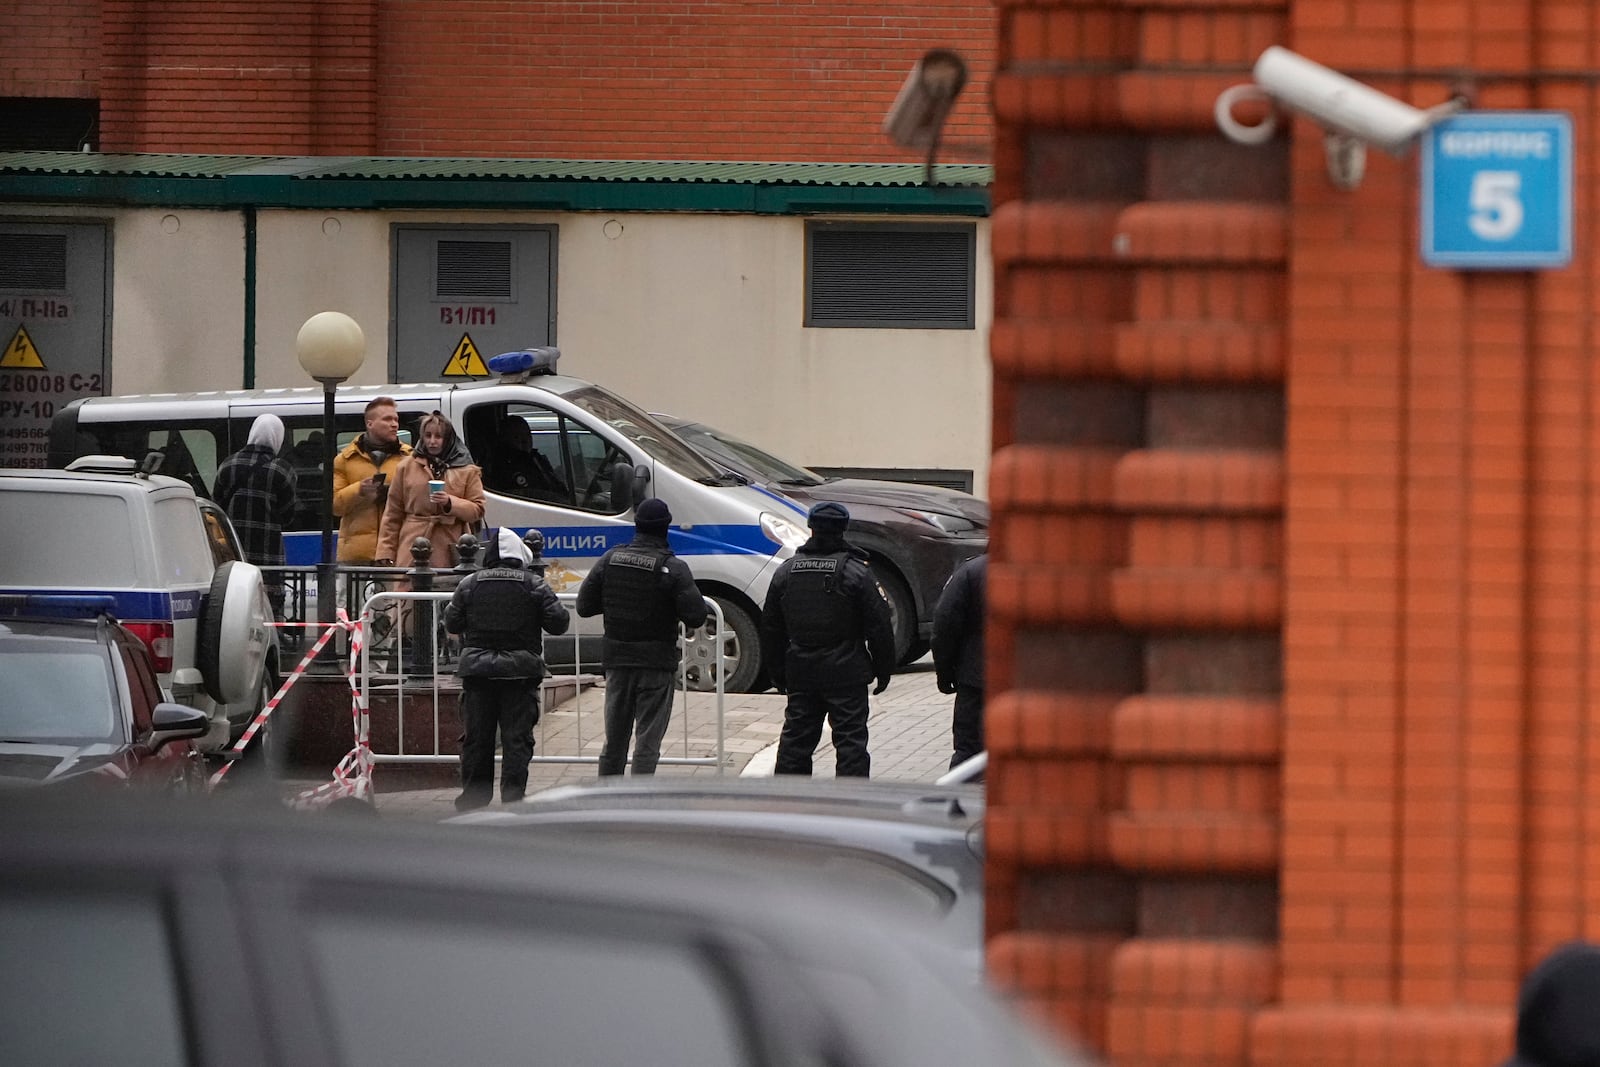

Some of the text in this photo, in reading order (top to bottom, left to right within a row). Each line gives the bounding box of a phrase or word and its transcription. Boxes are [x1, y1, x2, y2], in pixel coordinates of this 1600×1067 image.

[1469, 170, 1525, 241] 5
[543, 535, 607, 551] ИЦИЯ
[793, 560, 834, 570] ПОЛИЦИЯ
